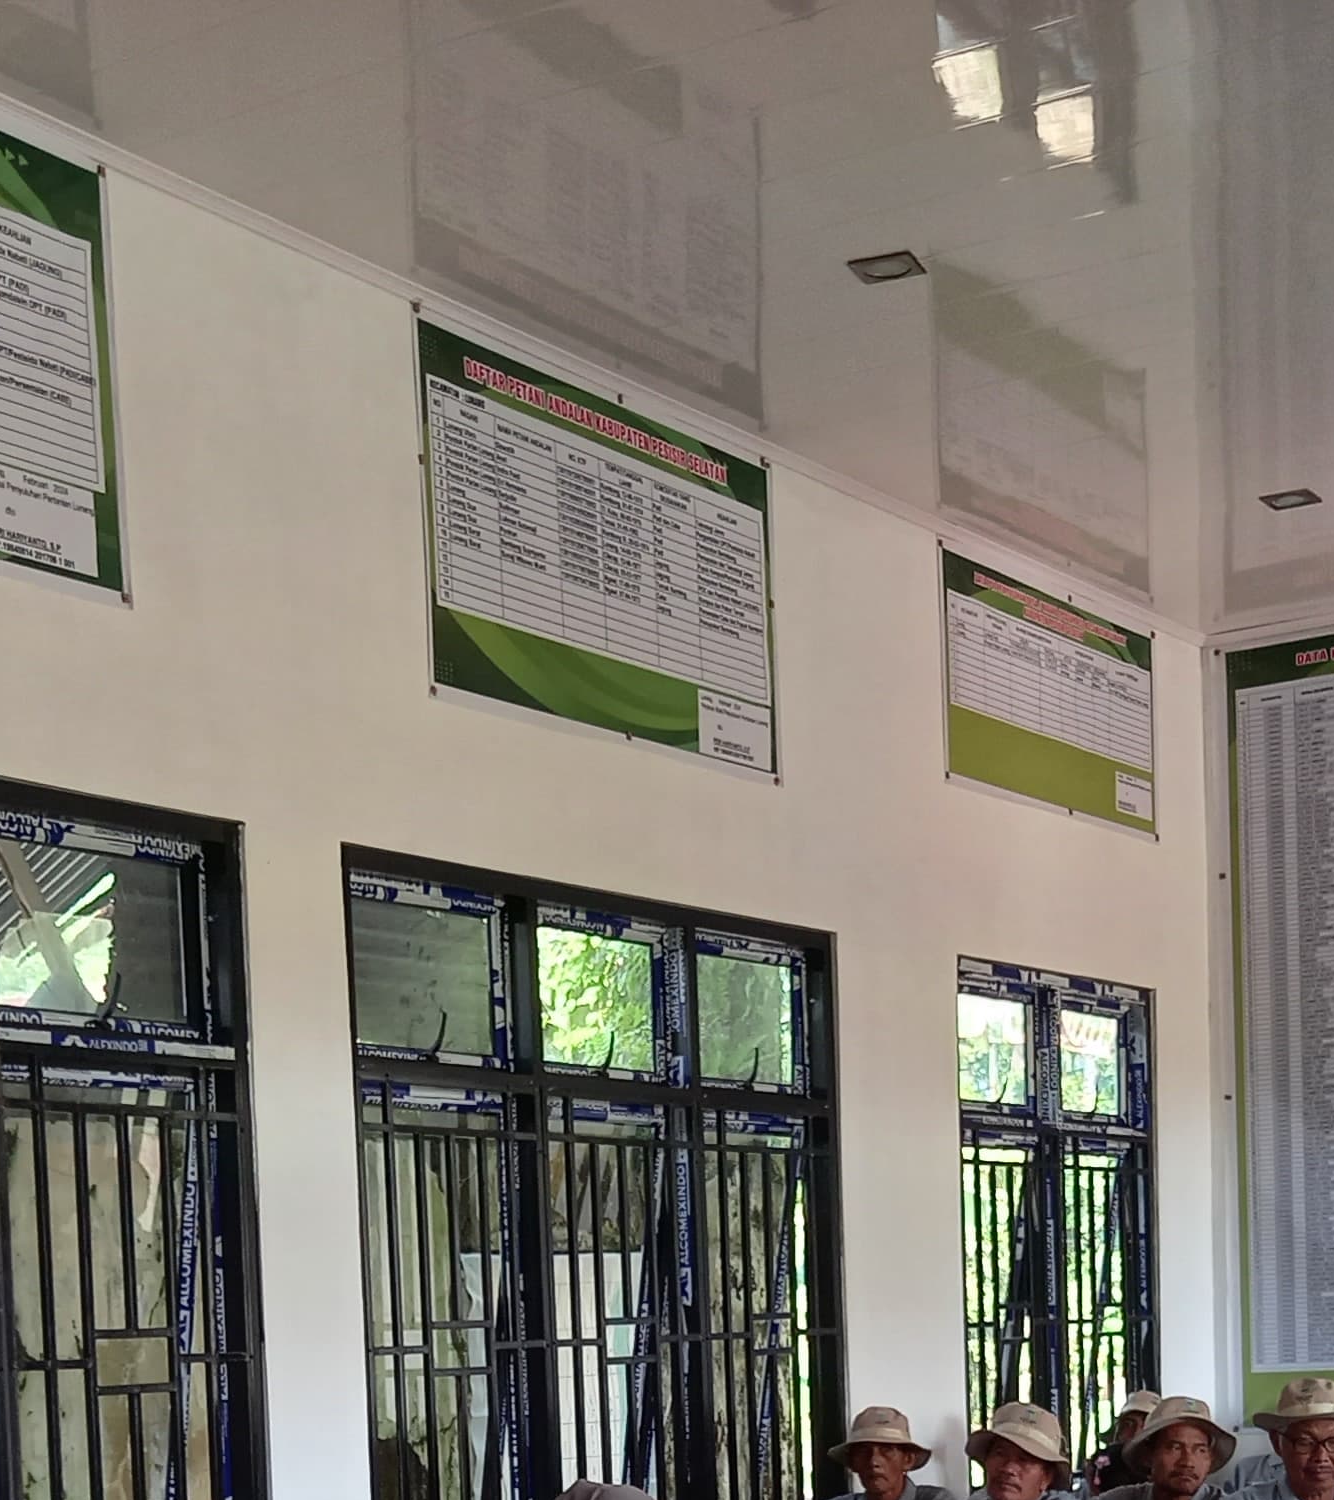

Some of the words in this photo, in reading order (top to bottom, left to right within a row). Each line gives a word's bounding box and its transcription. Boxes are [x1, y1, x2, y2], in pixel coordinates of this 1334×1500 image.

[464, 357, 508, 394] DAFTAR
[508, 375, 545, 411] PETANI
[547, 394, 594, 428] ANDALAN
[595, 412, 651, 451] KABUPATEN
[651, 436, 688, 469] PESISIR
[688, 451, 729, 487] SELATAN
[1295, 647, 1328, 667] DATA
[678, 1165, 691, 1266] ALCOMEXINDO
